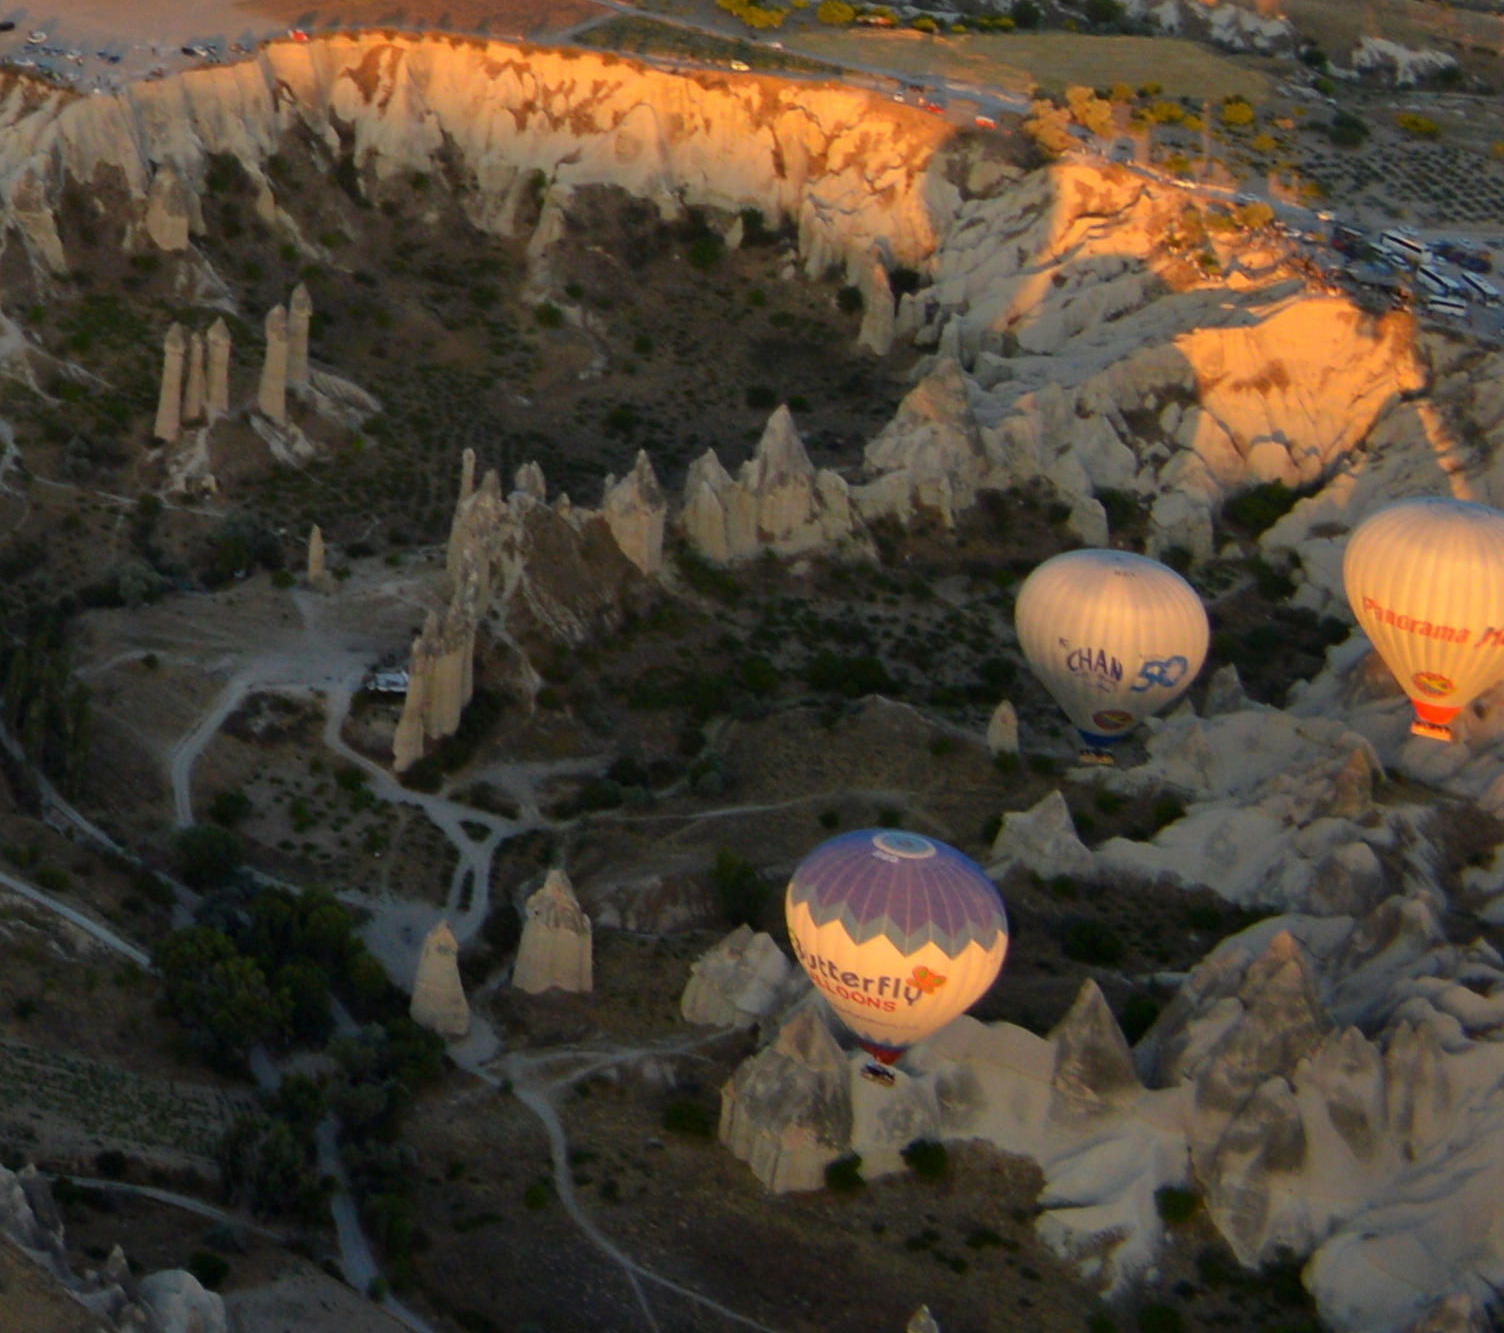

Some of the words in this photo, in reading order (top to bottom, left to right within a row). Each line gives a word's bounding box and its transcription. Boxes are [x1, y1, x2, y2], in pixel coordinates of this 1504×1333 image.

[1362, 596, 1470, 645] Panorama
[1066, 647, 1124, 682] CHAN
[1130, 655, 1188, 693] 50
